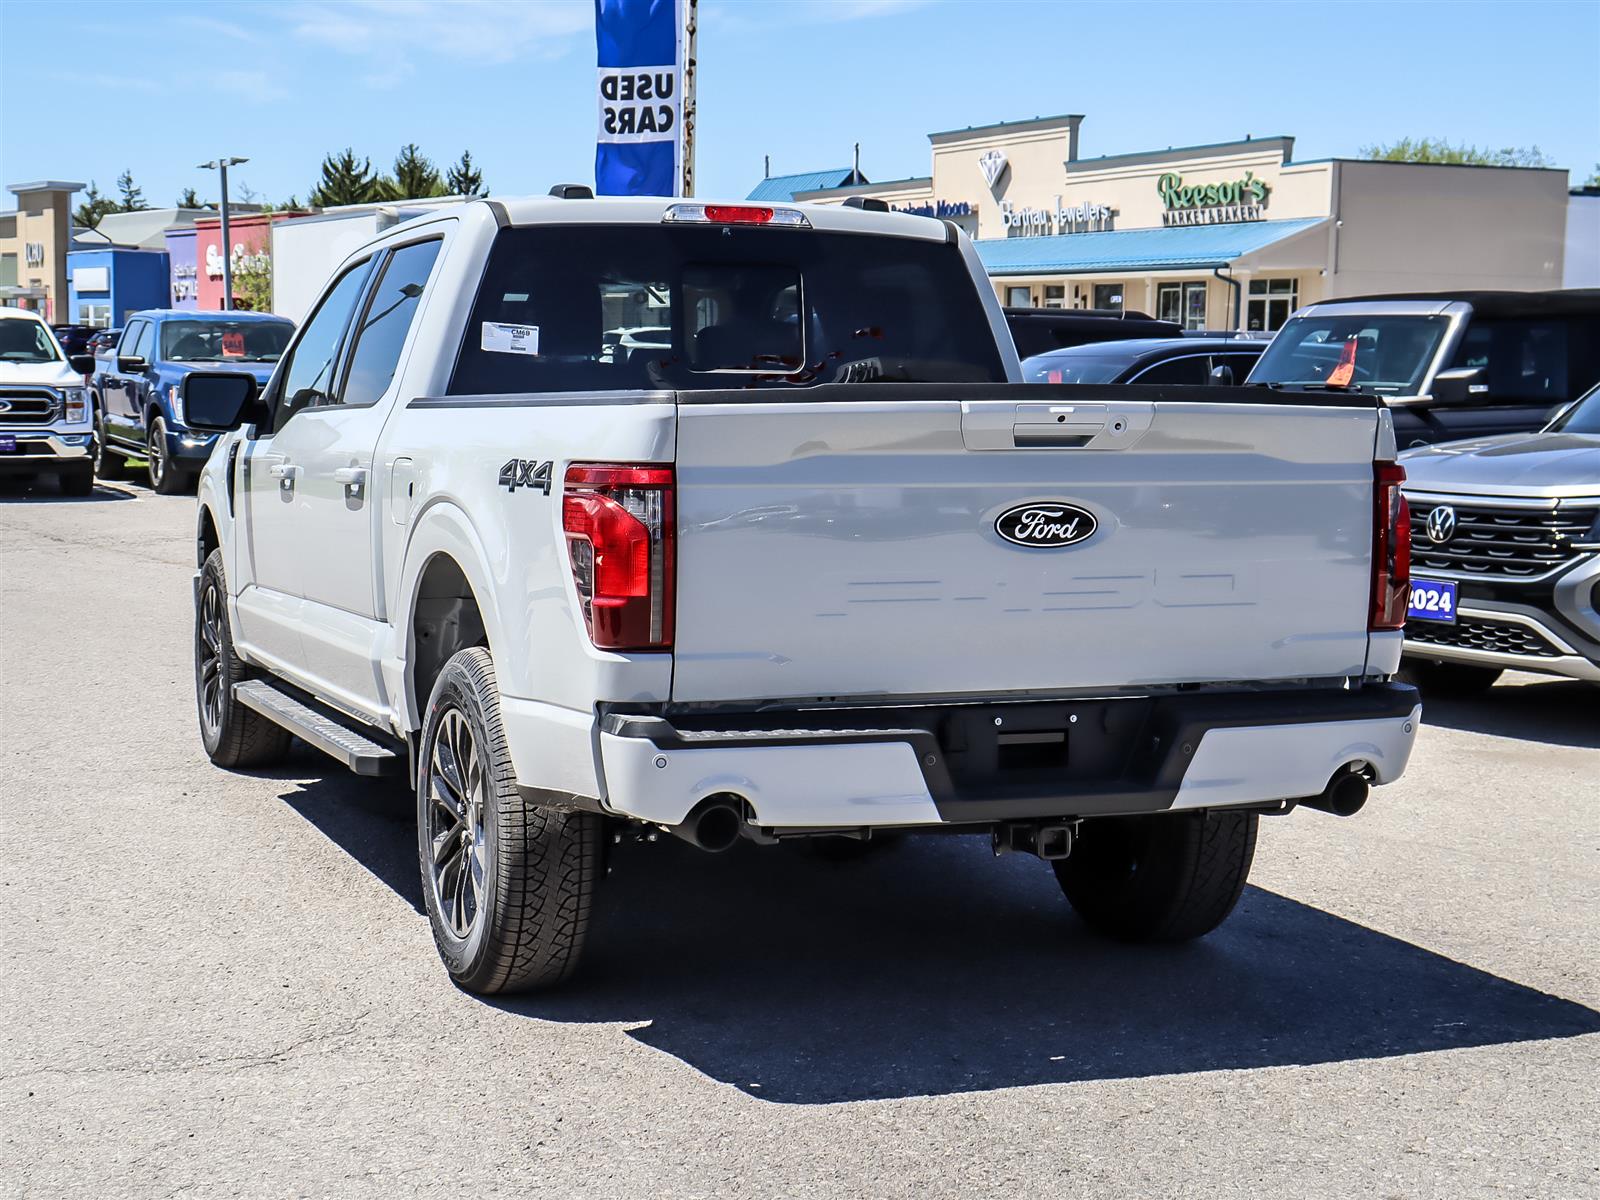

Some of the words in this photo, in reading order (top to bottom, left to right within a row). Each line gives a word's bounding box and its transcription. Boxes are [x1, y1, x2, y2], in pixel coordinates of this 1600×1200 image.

[1157, 170, 1266, 209] Reesor's
[999, 200, 1047, 229] Barthau
[1051, 196, 1112, 224] Jewellers
[1014, 509, 1080, 539] Ford
